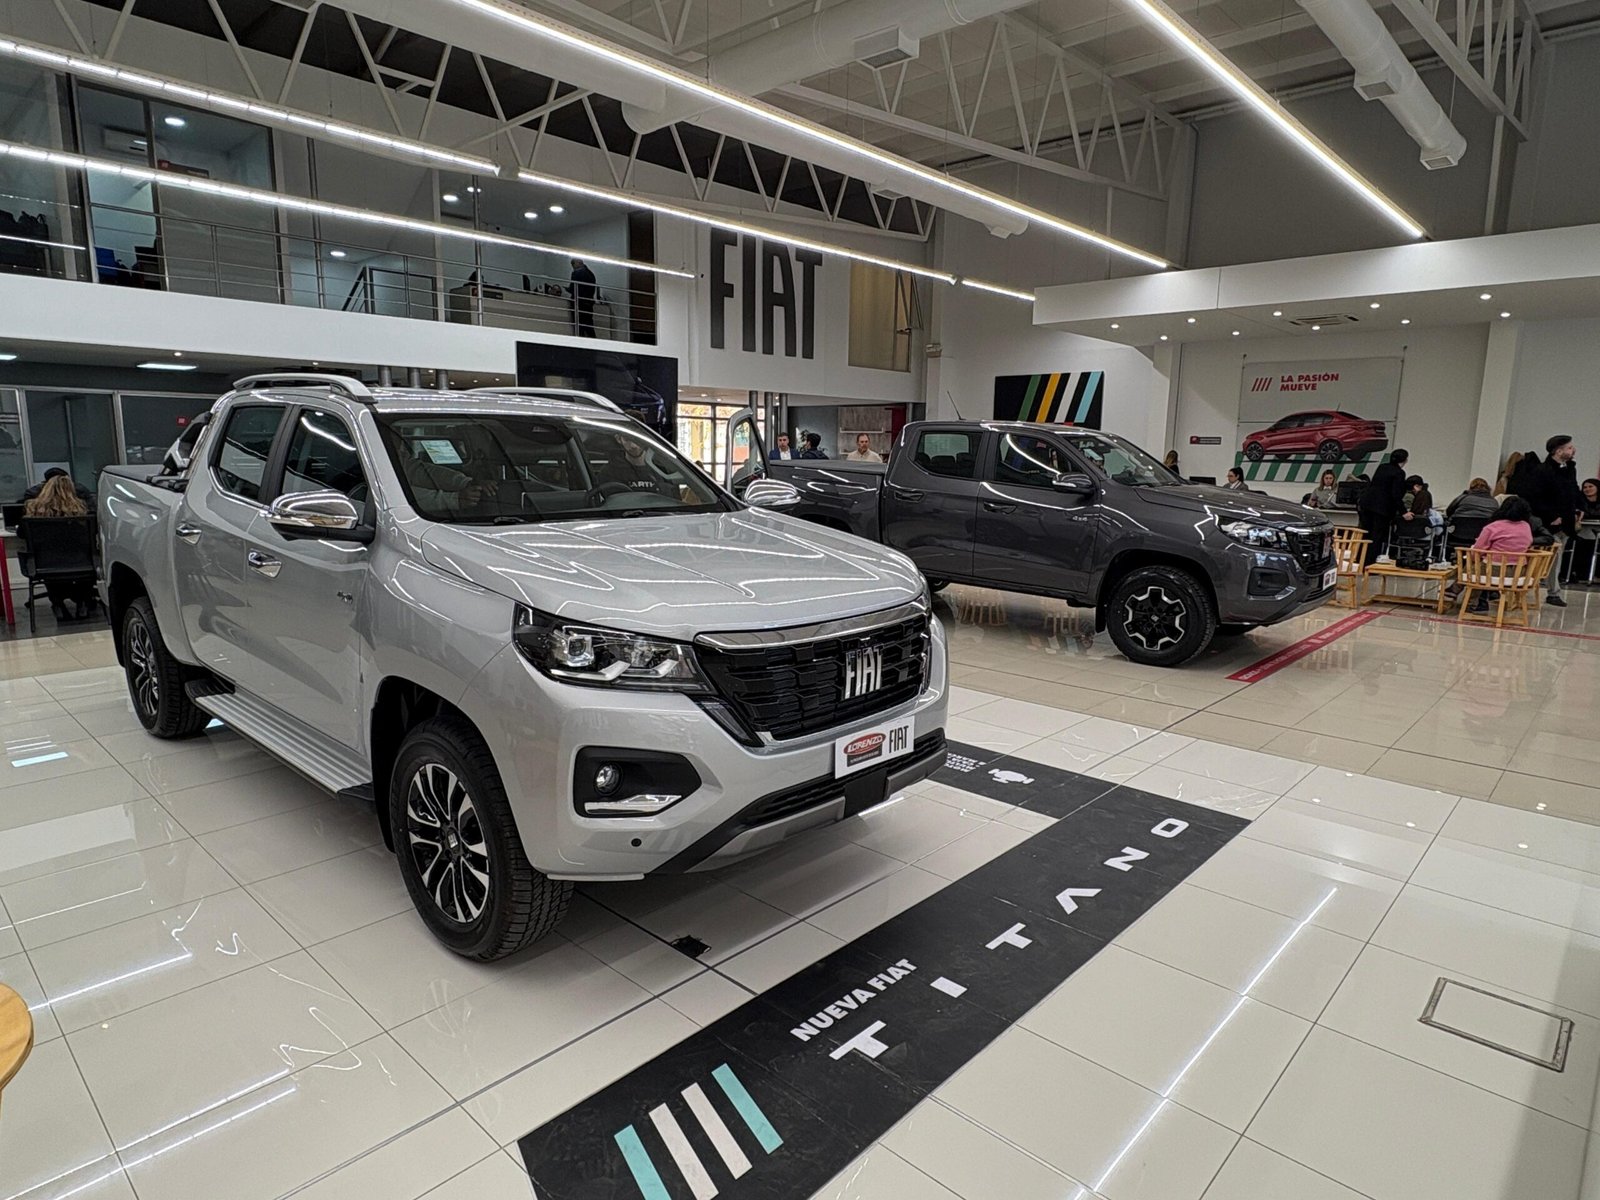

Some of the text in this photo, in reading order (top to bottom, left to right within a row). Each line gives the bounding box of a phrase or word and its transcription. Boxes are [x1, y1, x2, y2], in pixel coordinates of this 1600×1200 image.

[710, 227, 822, 360] FIAT
[1280, 383, 1317, 391] MUEVE
[1281, 372, 1340, 383] LA PASIÓN
[844, 646, 882, 699] FIAT
[847, 734, 883, 753] LORENZO
[889, 725, 909, 754] FIAT
[829, 817, 1189, 1060] TITANO
[790, 958, 917, 1042] NUEVA FIAT
